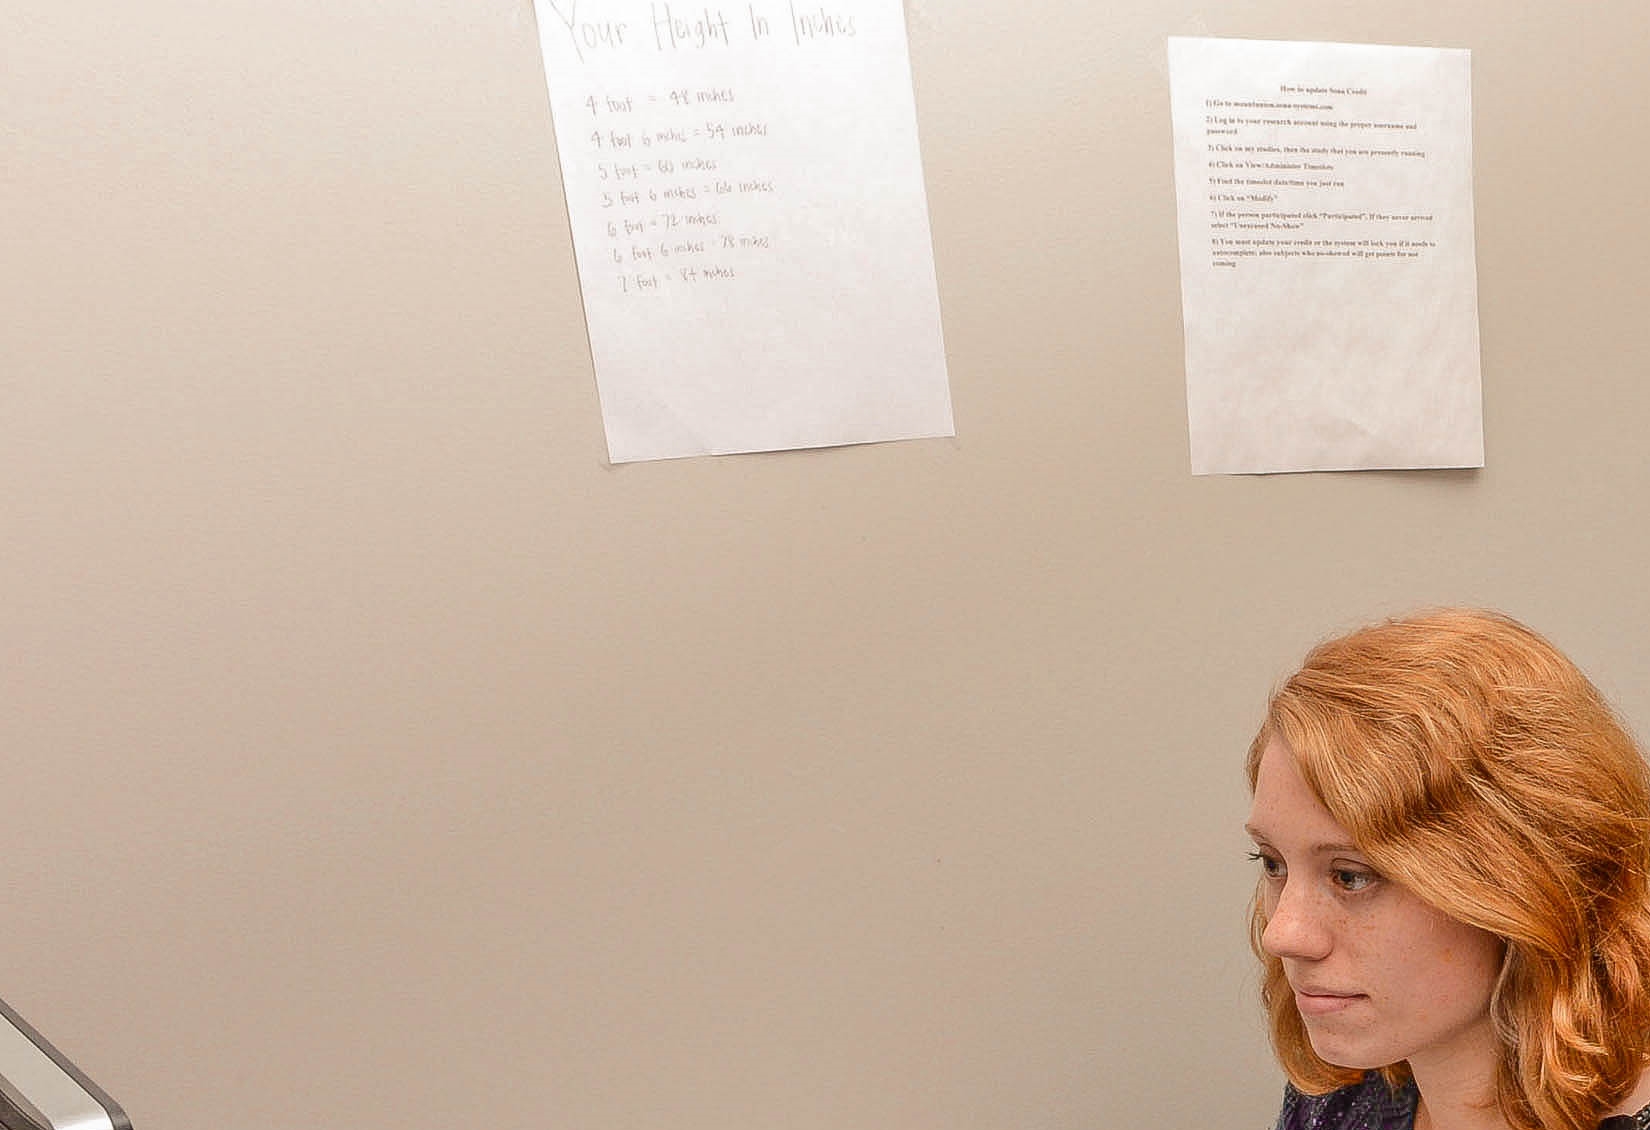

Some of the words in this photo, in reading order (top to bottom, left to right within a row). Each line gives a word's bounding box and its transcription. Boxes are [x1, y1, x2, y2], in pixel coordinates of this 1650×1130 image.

[550, 0, 628, 63] Your
[650, 2, 729, 51] Height
[748, 3, 769, 41] In
[790, 0, 857, 46] Inches
